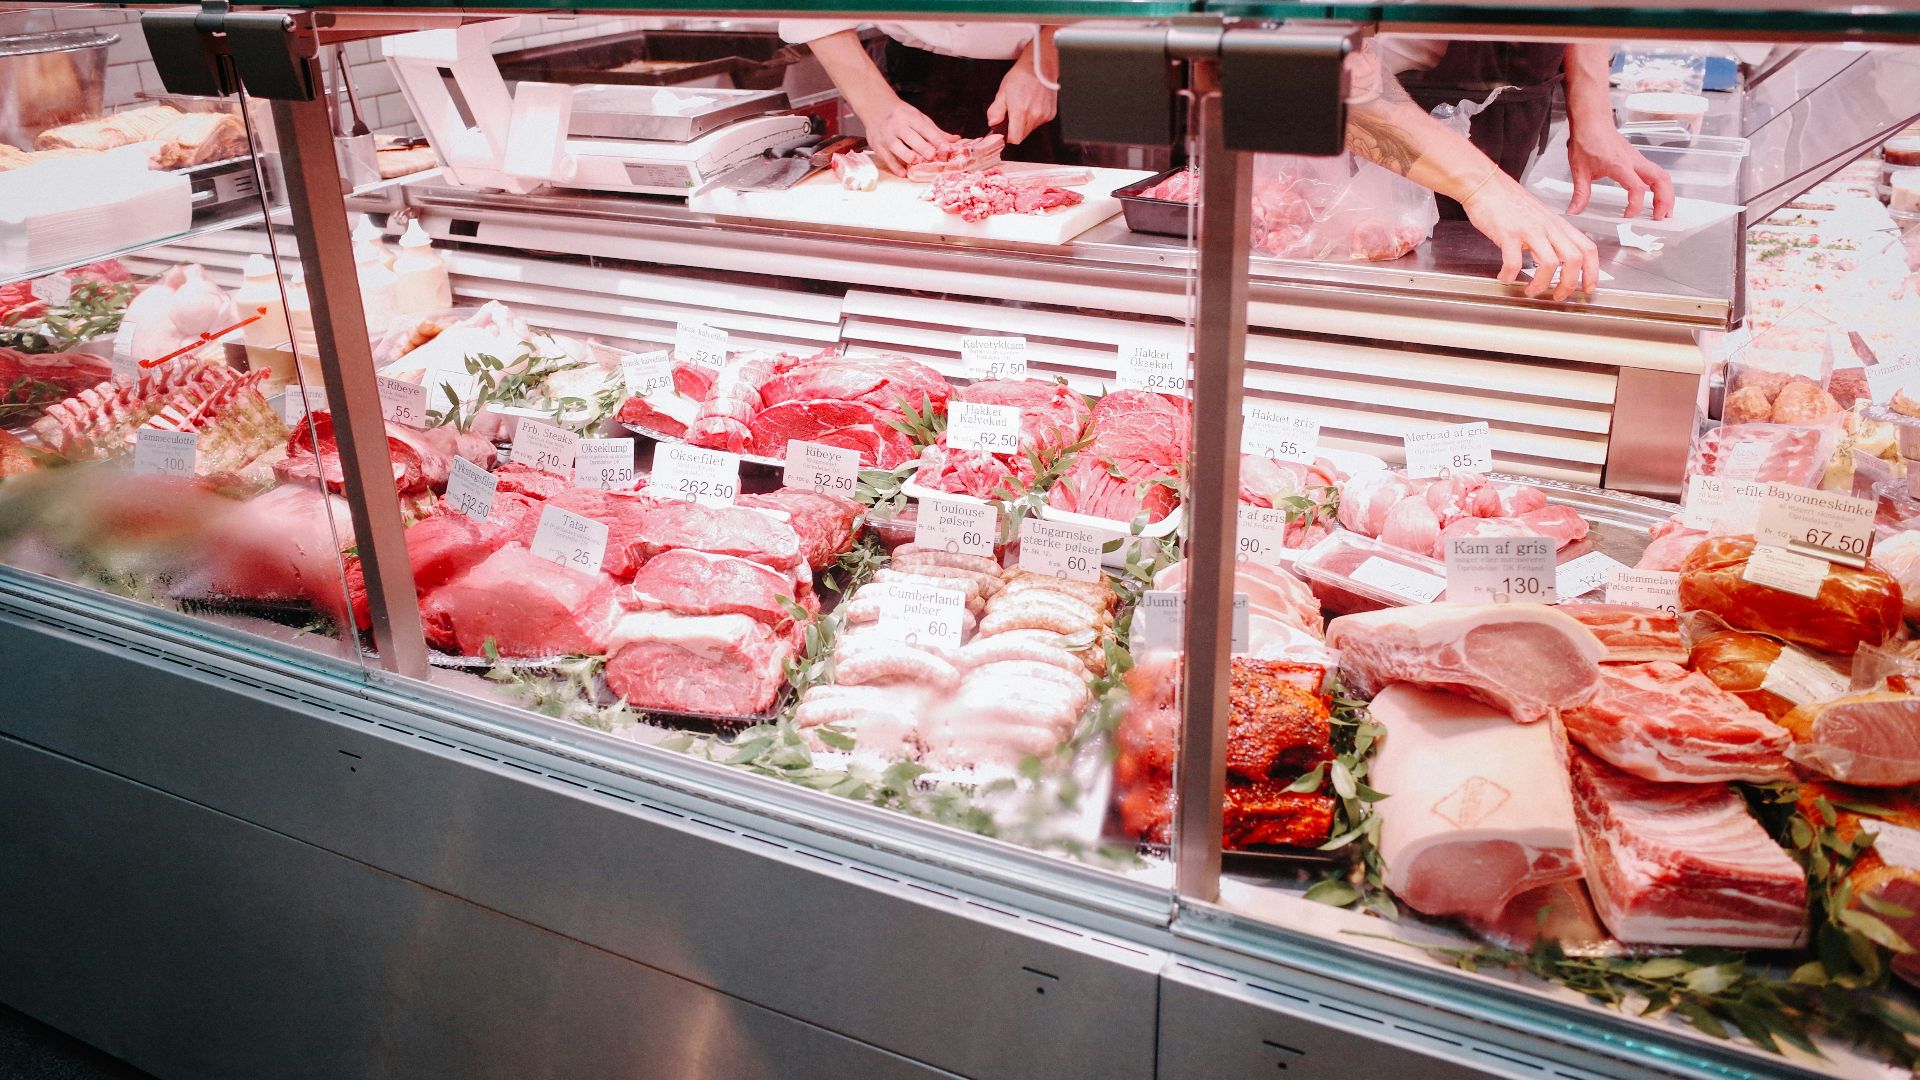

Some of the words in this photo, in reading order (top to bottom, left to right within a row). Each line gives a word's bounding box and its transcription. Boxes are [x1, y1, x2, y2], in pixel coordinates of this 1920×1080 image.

[991, 362, 1025, 375] 67,50
[388, 380, 420, 397] Ribeye
[1148, 374, 1185, 390] 62,50
[396, 405, 419, 421] 55,-
[1251, 408, 1289, 422] Hakket
[1293, 417, 1313, 430] gris
[522, 422, 541, 437] Frb.
[543, 429, 573, 446] Steaks
[980, 432, 1017, 447] 62,50
[1453, 426, 1465, 438] af
[1468, 425, 1489, 439] gris
[670, 449, 724, 467] Oksefilet
[806, 446, 842, 462] Ribeye
[1280, 441, 1307, 458] 55,-
[537, 451, 567, 470] 210,-
[1453, 454, 1484, 469] 85,-
[602, 469, 632, 485] 92,50
[814, 472, 852, 491] 52,50
[680, 478, 733, 499] 262,50
[932, 500, 985, 518] Toulouse
[1768, 485, 1873, 518] Bayonneskinke
[563, 514, 589, 533] Tatar
[939, 515, 975, 529] pølser
[1247, 509, 1260, 520] af
[1263, 512, 1285, 524] gris
[963, 531, 991, 548] 60,-
[1032, 522, 1093, 543] Ungarnske
[1023, 535, 1061, 549] stærke
[1065, 542, 1101, 556] pølser
[1240, 537, 1271, 555] 90,-
[1454, 541, 1489, 554] Kam
[1495, 540, 1511, 554] af
[1516, 541, 1548, 557] gris
[573, 548, 598, 569] 25,-
[1068, 556, 1097, 574] 60,-
[888, 585, 960, 607] Cumberland
[1502, 577, 1554, 597] 130,-
[929, 620, 959, 639] 60,-
